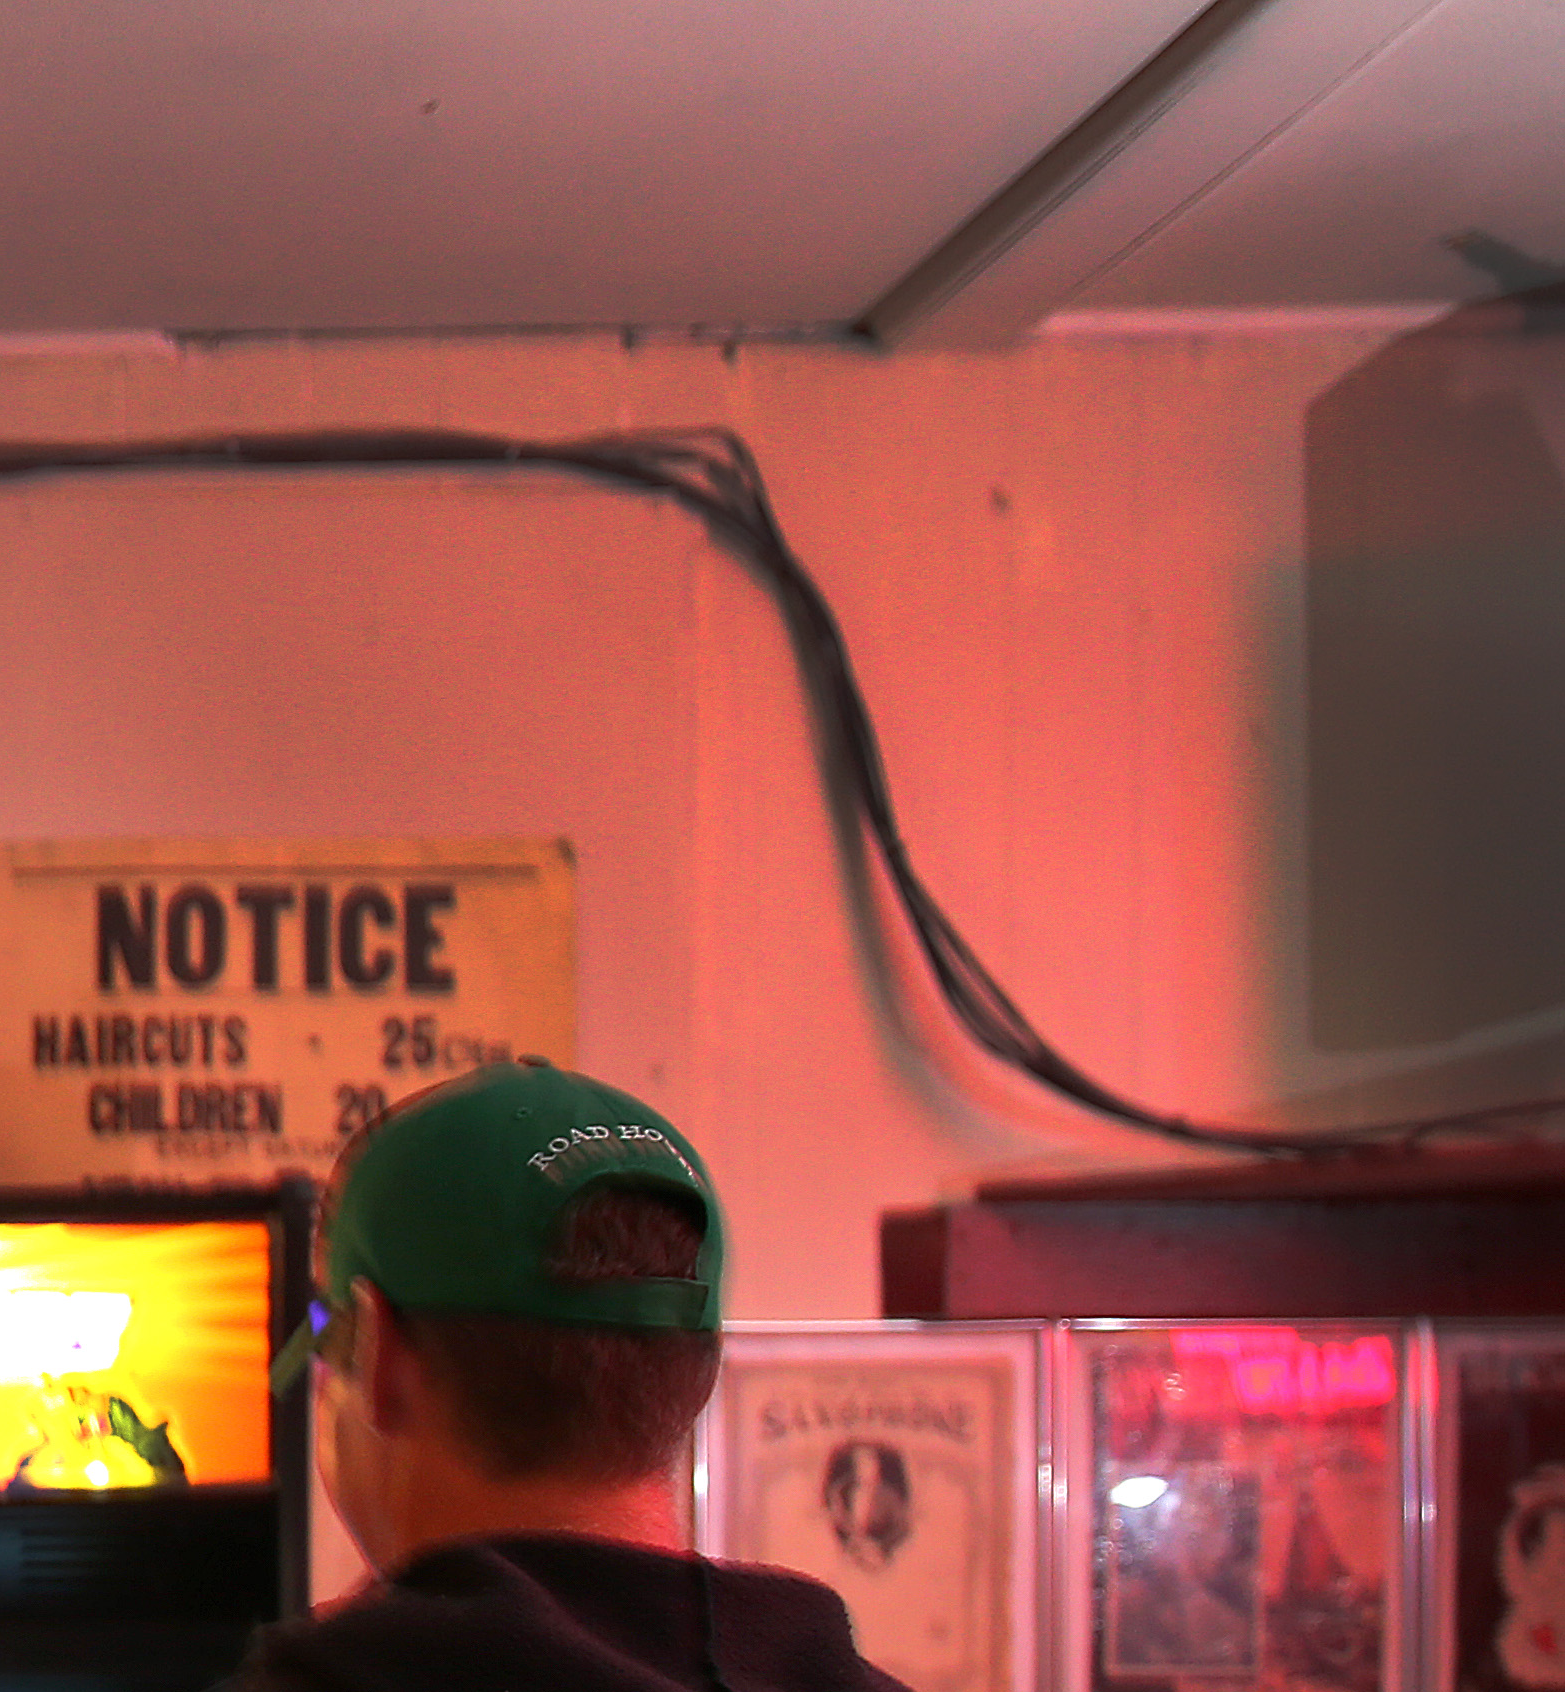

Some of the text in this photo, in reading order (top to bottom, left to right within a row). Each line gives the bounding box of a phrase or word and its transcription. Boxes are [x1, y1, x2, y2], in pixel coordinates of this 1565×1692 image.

[94, 883, 458, 994] NOTICE
[32, 1014, 249, 1070] HAIRCUTS
[382, 1015, 438, 1070] 25
[88, 1083, 388, 1135] CHILDREN 20
[526, 1125, 611, 1172] ROAD
